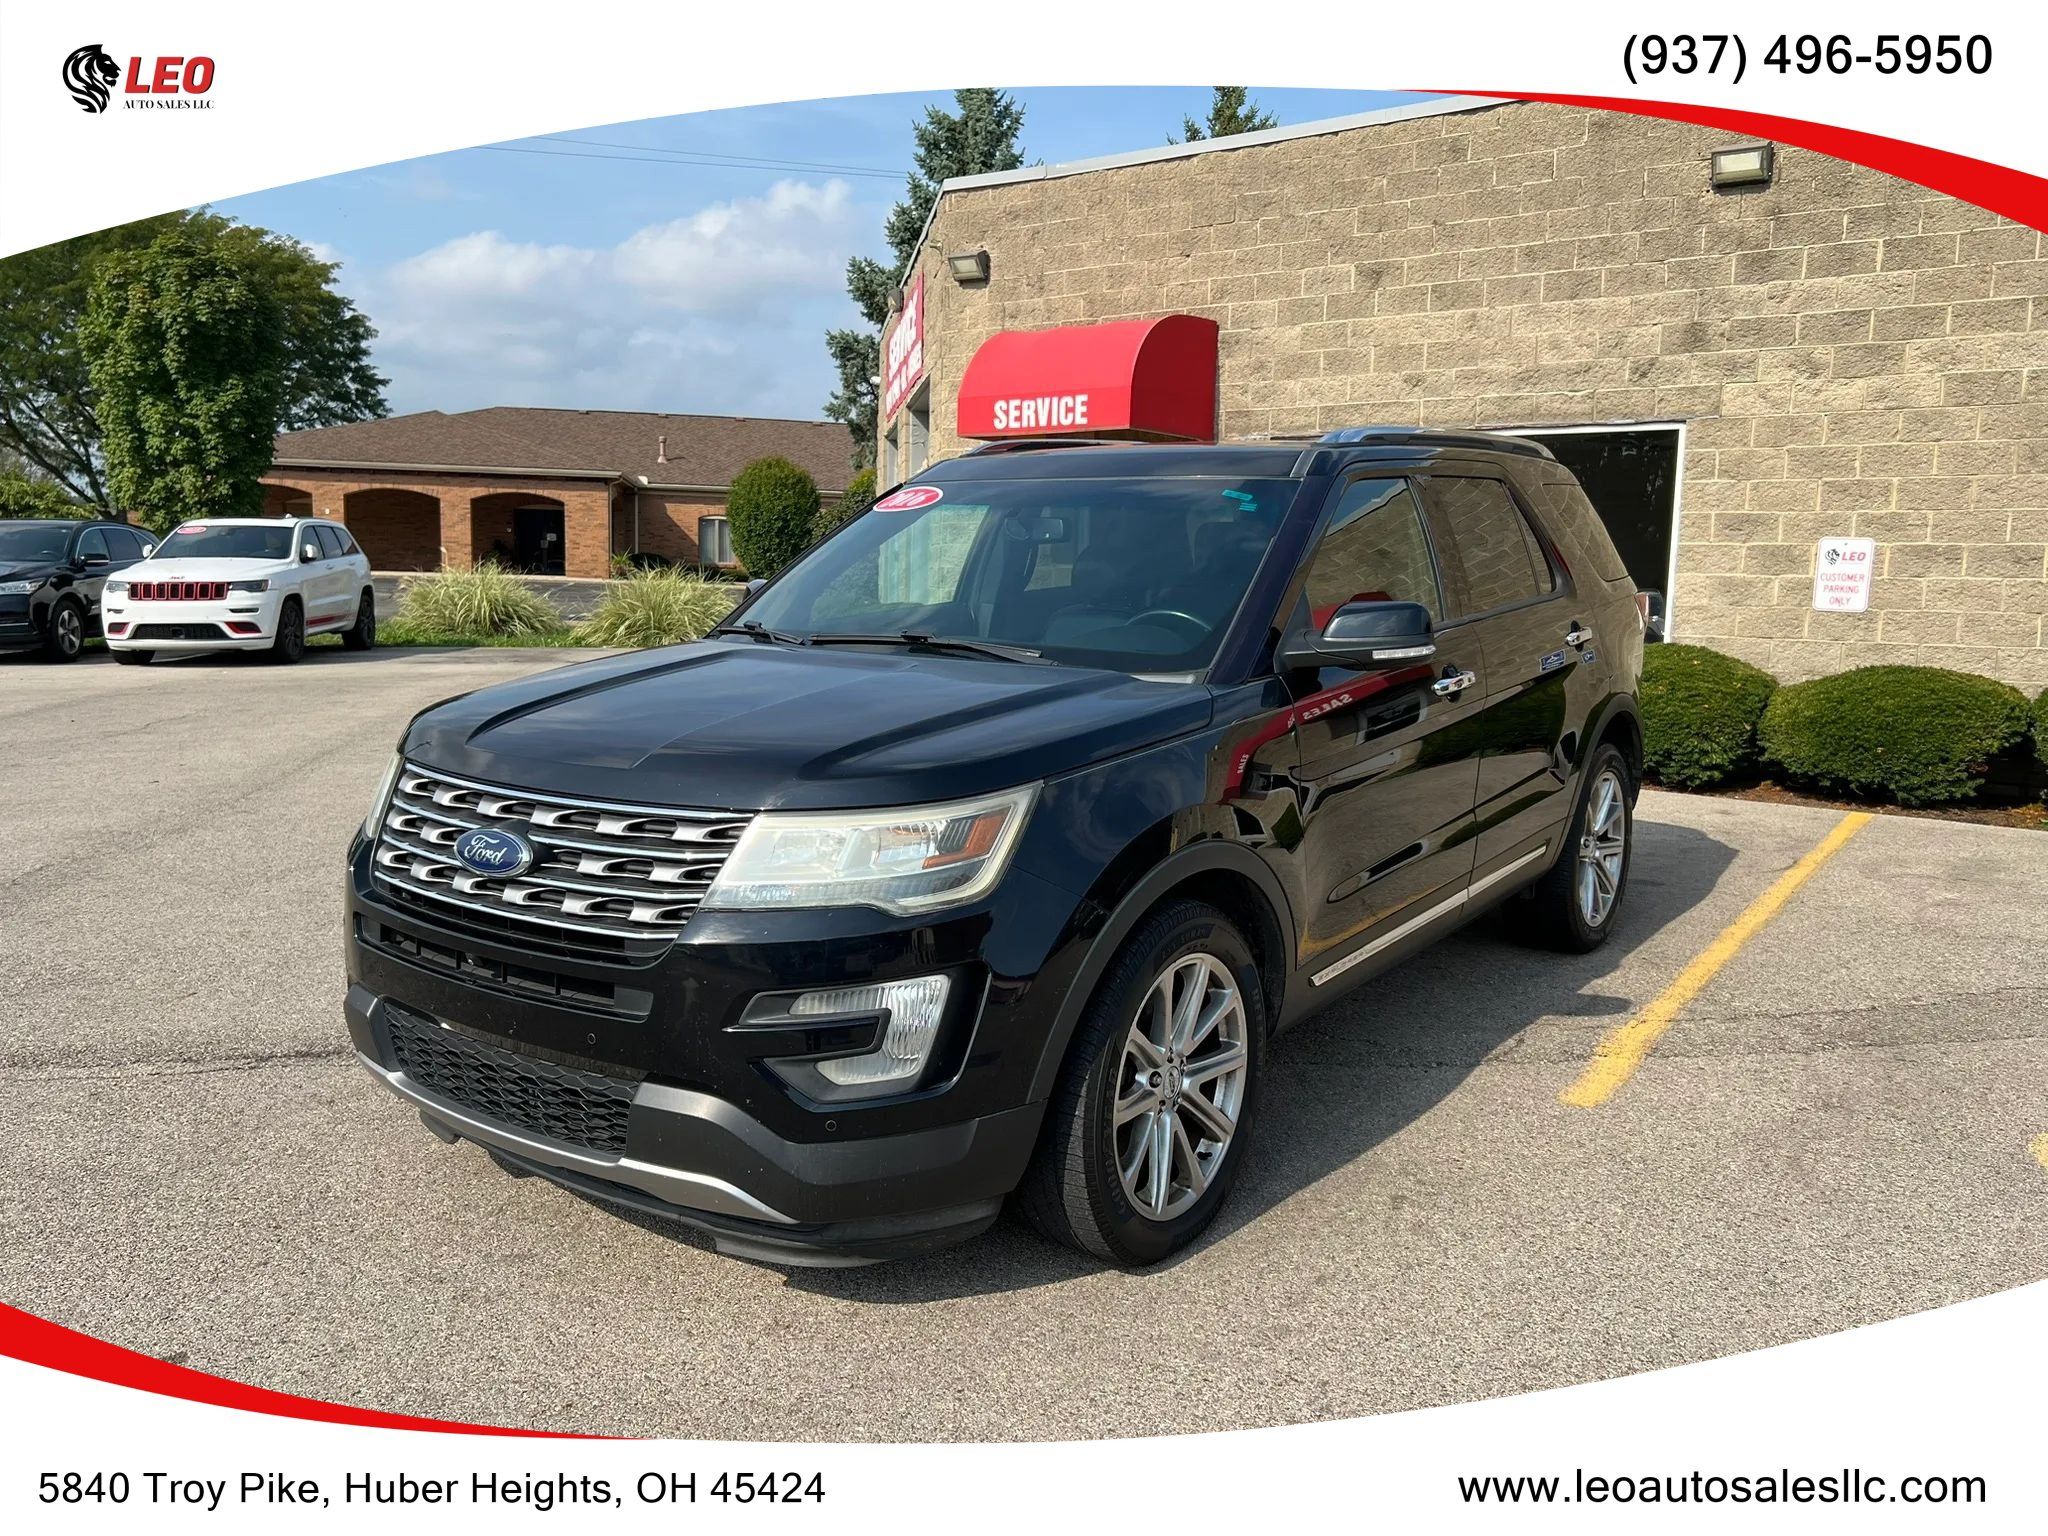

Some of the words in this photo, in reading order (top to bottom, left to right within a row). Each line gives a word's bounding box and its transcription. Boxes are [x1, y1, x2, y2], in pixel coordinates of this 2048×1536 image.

[993, 393, 1089, 430] SERVICE
[1841, 551, 1866, 561] LEO
[1820, 572, 1865, 582] CUSTOMER
[1823, 585, 1860, 594] PARKING
[1829, 597, 1851, 606] ONLY
[464, 834, 508, 866] Ford
